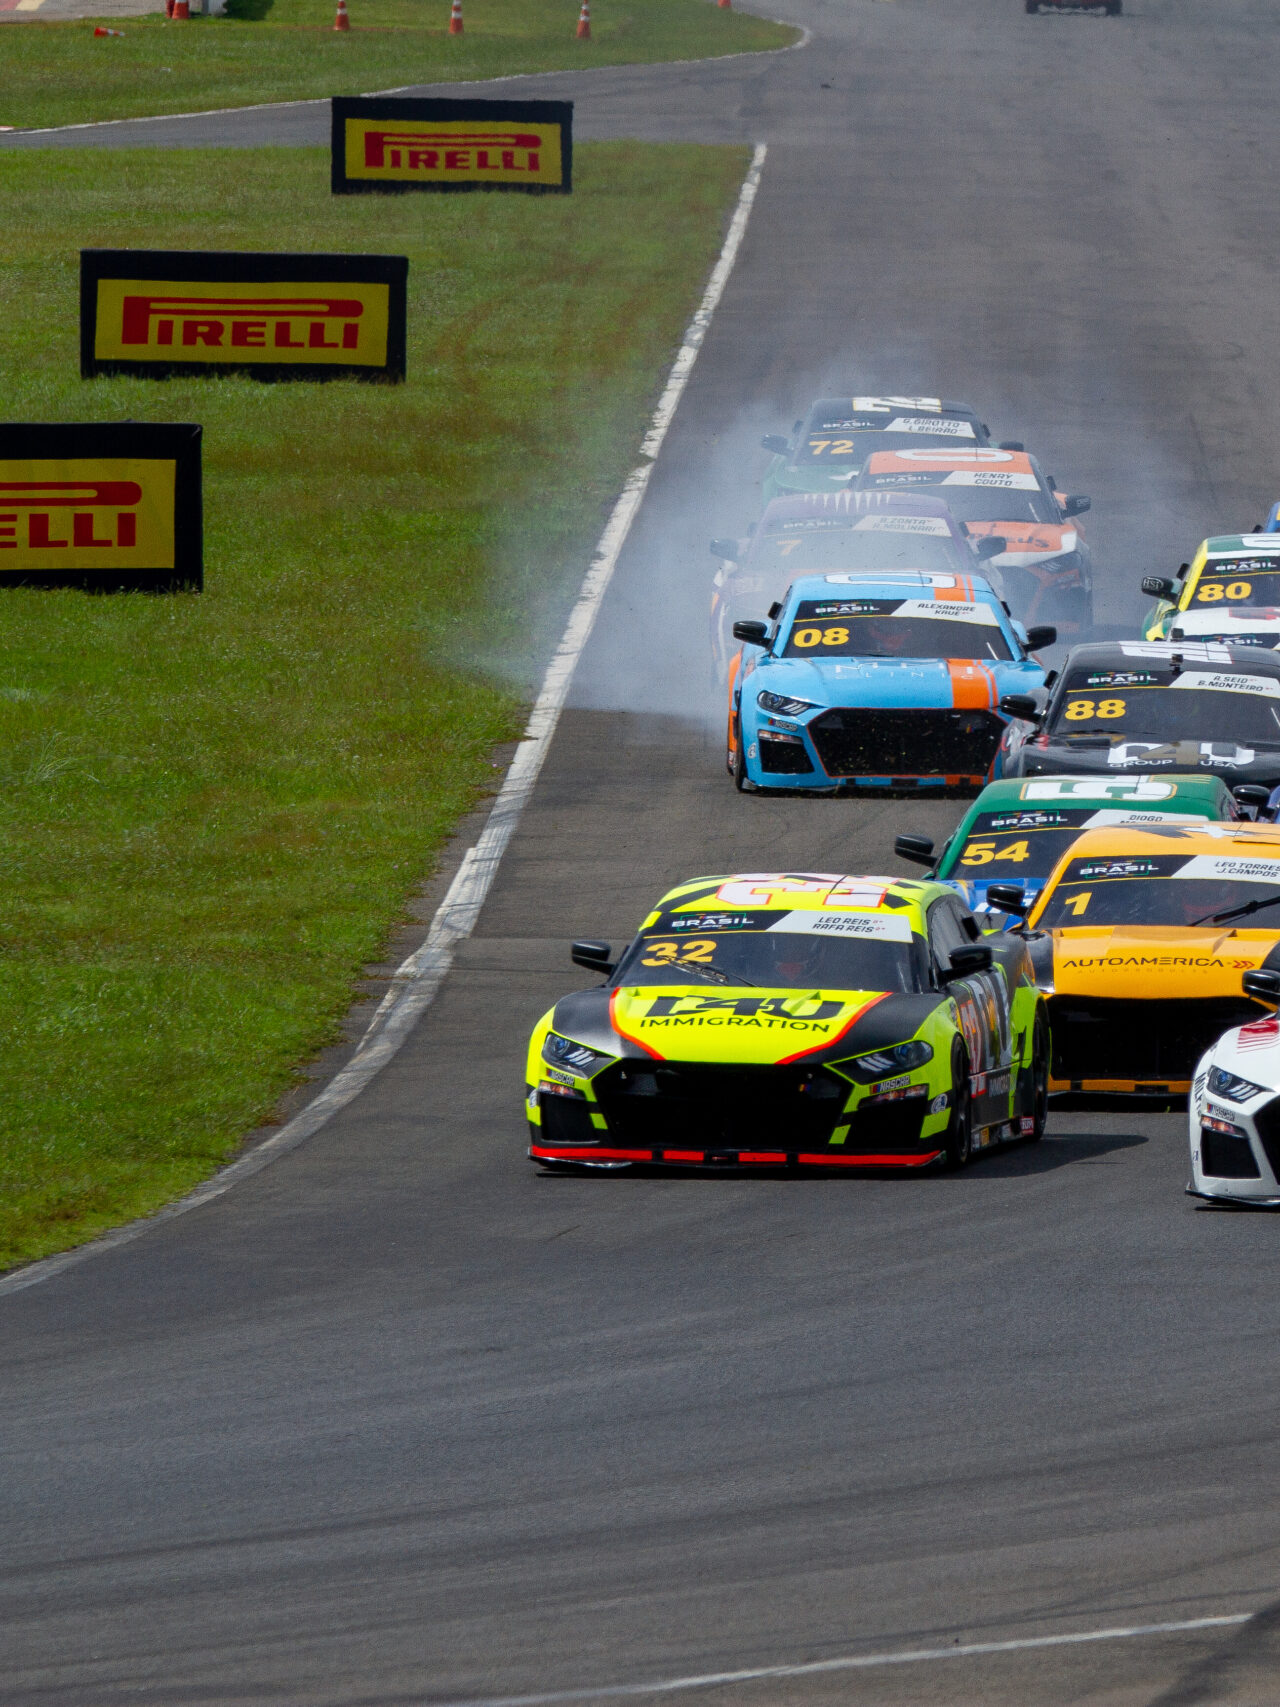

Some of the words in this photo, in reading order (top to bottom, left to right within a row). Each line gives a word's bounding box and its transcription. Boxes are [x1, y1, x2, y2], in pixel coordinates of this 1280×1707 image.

[364, 131, 541, 172] PIRELLI
[122, 296, 363, 349] PIRELLI
[809, 440, 854, 455] 72
[974, 472, 1013, 480] HENRY
[974, 478, 1013, 487] COUTO
[1215, 562, 1277, 571] BRASIL
[1196, 581, 1252, 602] 80
[815, 605, 880, 614] BRASIL
[918, 603, 977, 613] ALEXANDRE
[793, 627, 850, 648] 08
[1087, 674, 1158, 684] BRASIL
[1065, 699, 1126, 720] 88
[1110, 759, 1173, 768] GROUP
[1200, 760, 1238, 769] USA
[991, 813, 1069, 827] BRASIL
[1128, 814, 1163, 822] DIOGO
[960, 840, 1029, 865] 54
[1079, 863, 1159, 875] BRASIL
[1214, 861, 1234, 869] LEO
[1216, 867, 1278, 878] J.CAMPOS
[1064, 892, 1092, 915] 1
[671, 917, 754, 928] BRASIL
[818, 916, 842, 925] LEO
[845, 917, 871, 926] REIS
[812, 922, 845, 931] RAFA
[847, 924, 875, 933] REIS
[641, 940, 717, 966] 32
[1063, 957, 1223, 968] AUTOAMERICA
[640, 1016, 830, 1032] IMMIGRATION
[878, 1075, 910, 1091] NASCAR
